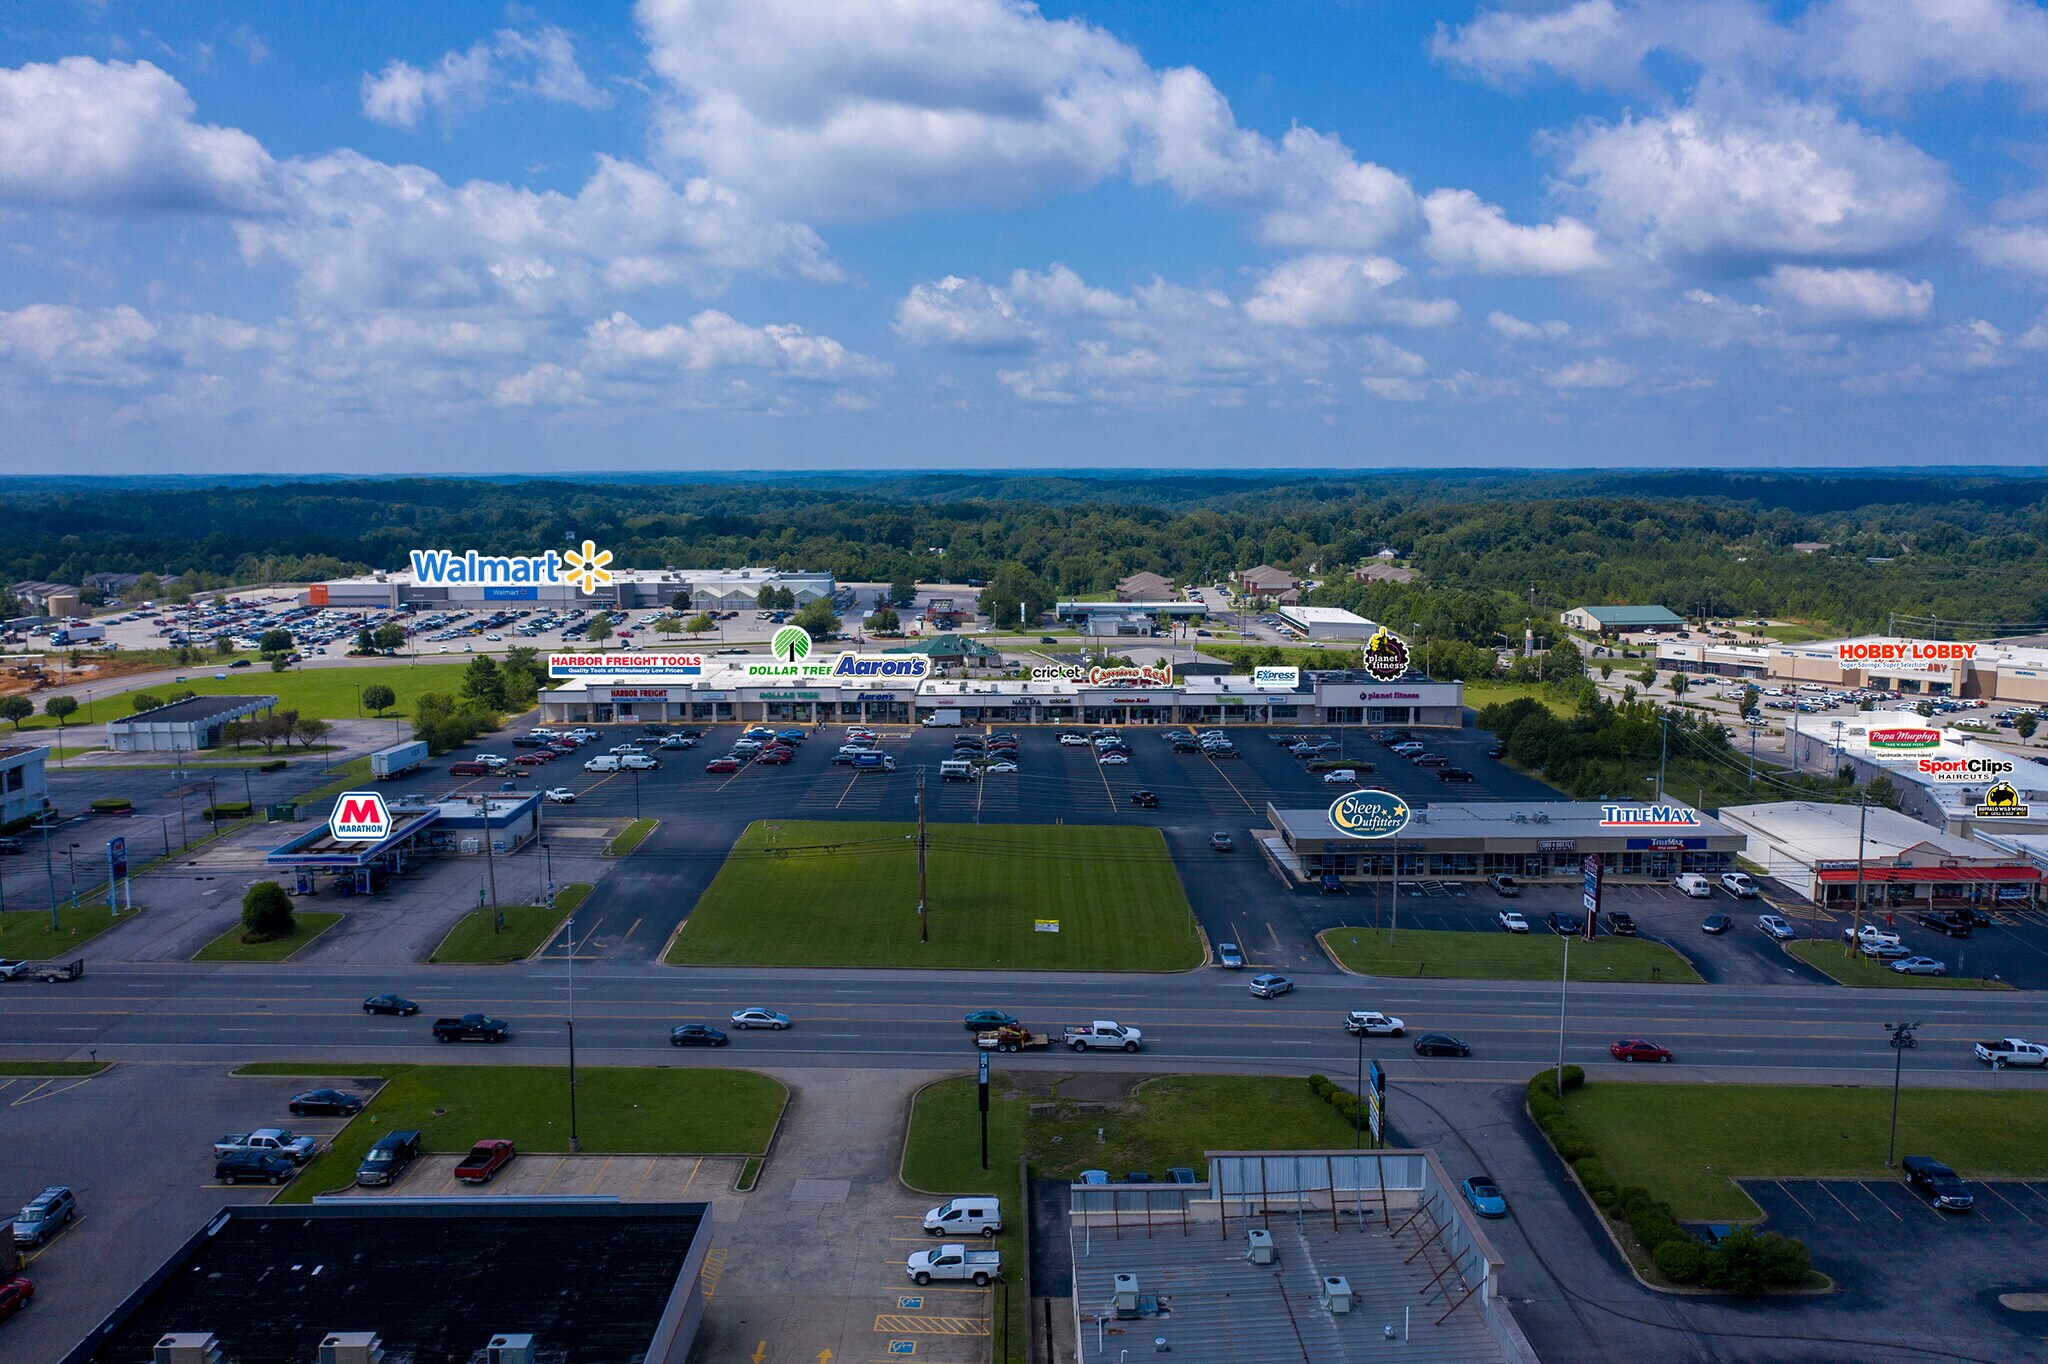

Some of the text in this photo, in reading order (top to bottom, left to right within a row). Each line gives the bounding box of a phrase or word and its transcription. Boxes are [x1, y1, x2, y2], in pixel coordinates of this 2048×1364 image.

[492, 588, 519, 596] Walmart
[611, 689, 638, 697] HARBOR
[857, 692, 895, 700] Aaron's
[1368, 692, 1392, 700] planet
